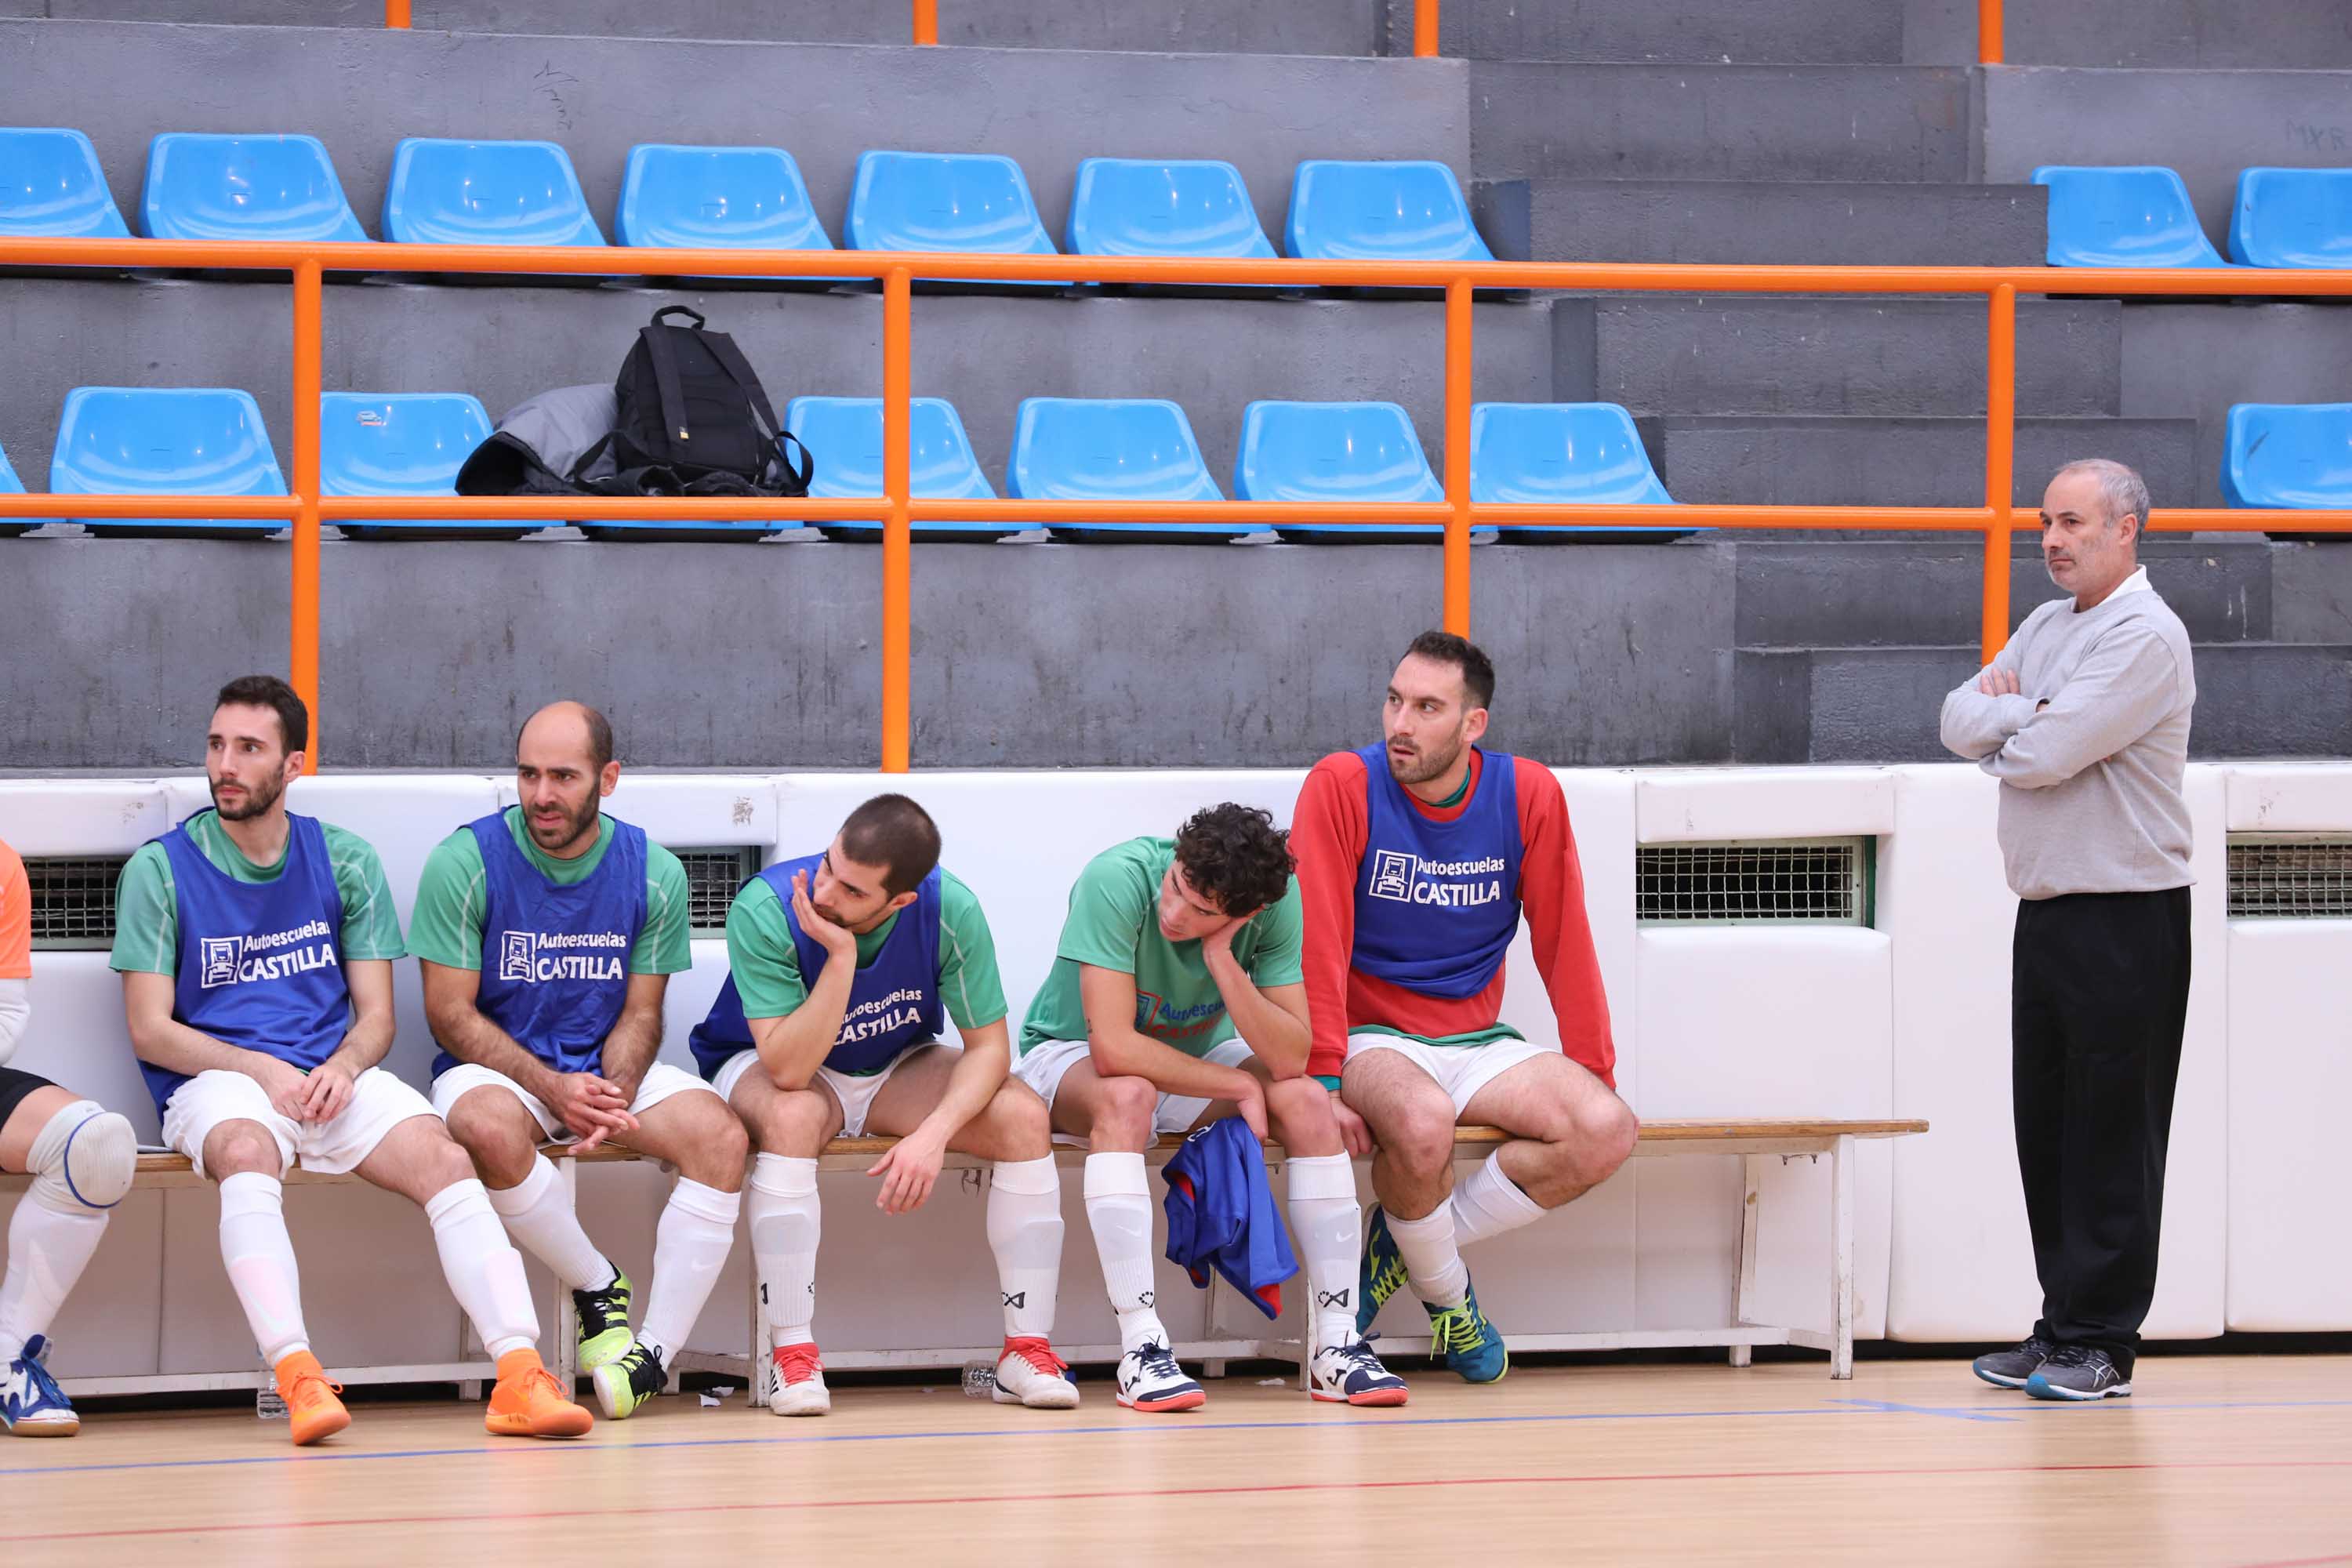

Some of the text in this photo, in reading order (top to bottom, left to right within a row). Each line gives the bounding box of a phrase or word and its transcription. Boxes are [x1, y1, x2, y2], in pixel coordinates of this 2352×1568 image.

[1417, 856, 1504, 876] Autoescuelas
[1414, 880, 1501, 906] CASTILLA
[537, 931, 626, 949] Autoescuelas
[238, 943, 337, 982] CASTILLA
[536, 956, 623, 982] CASTILLA
[842, 989, 922, 1024] utoescuelas
